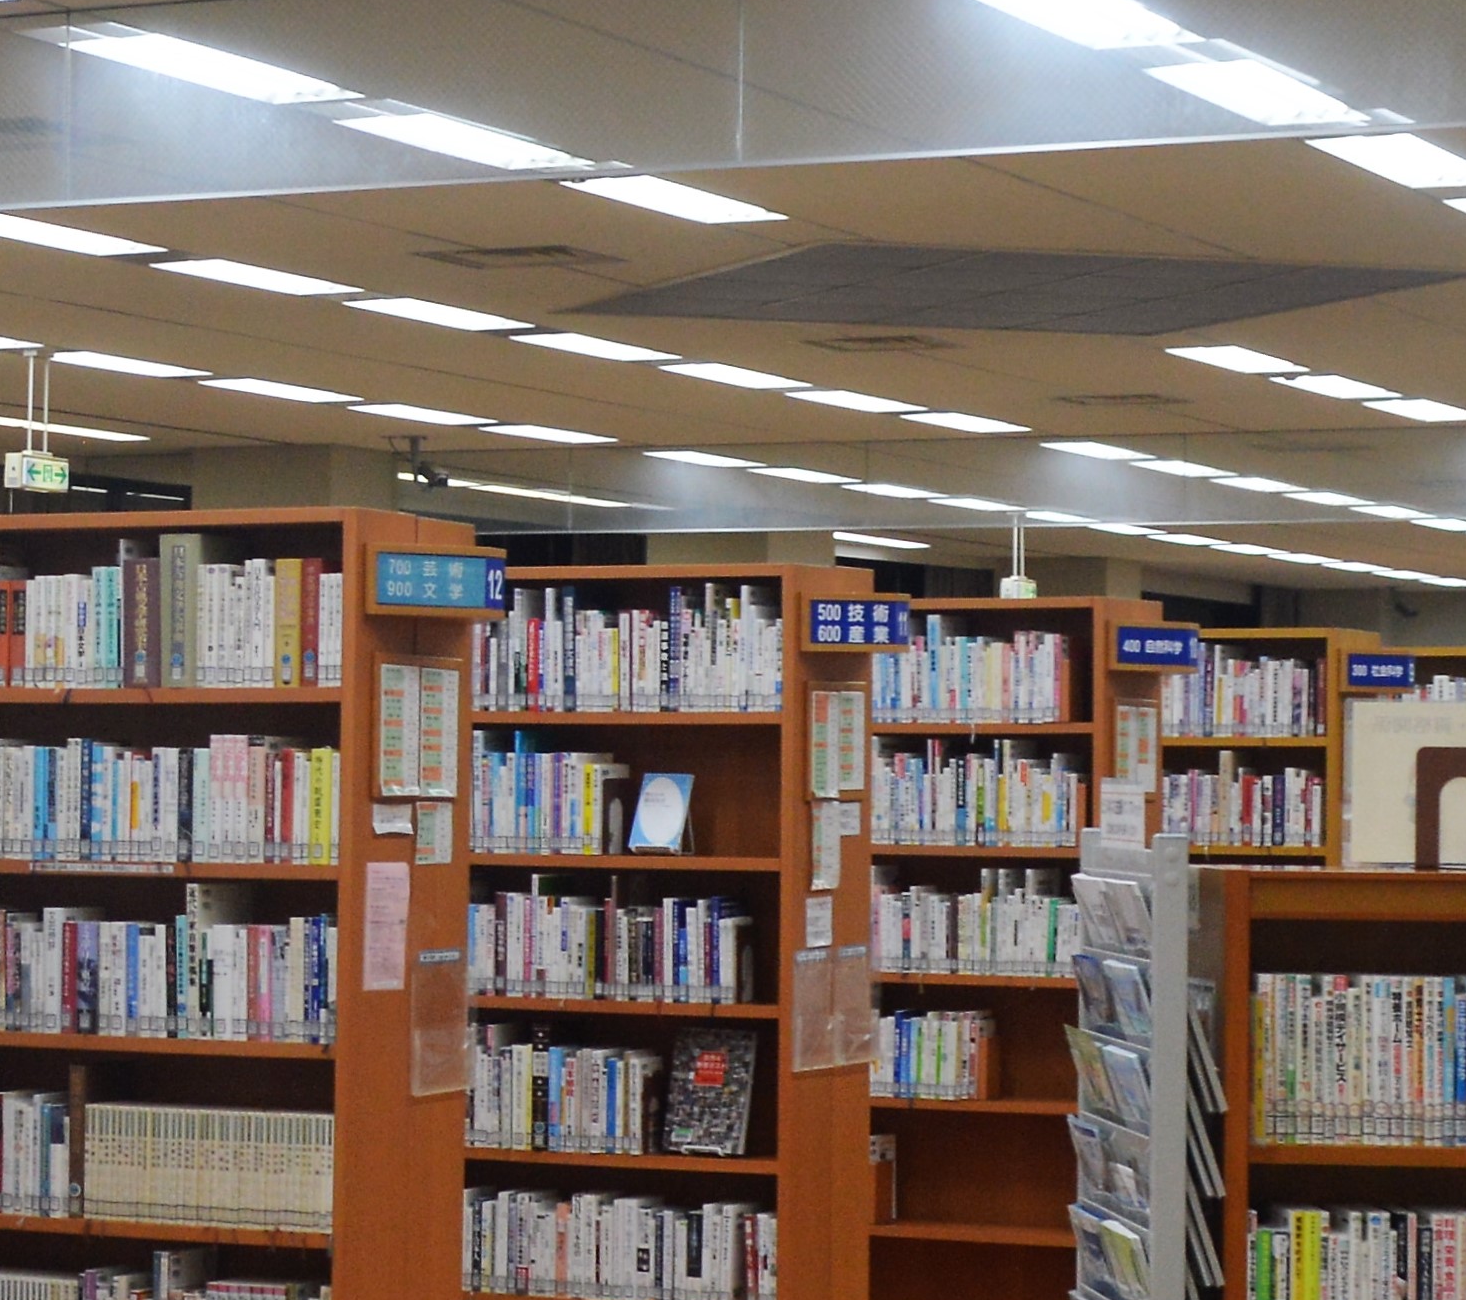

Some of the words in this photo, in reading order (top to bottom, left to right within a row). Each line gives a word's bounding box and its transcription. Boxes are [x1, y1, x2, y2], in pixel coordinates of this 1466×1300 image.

[389, 559, 412, 575] 700
[387, 580, 412, 597] 900
[423, 582, 463, 600] 文学
[487, 570, 503, 600] 12
[818, 604, 841, 621] 500
[848, 604, 889, 622] 技術
[818, 625, 841, 642] 600
[1123, 639, 1141, 653] 400
